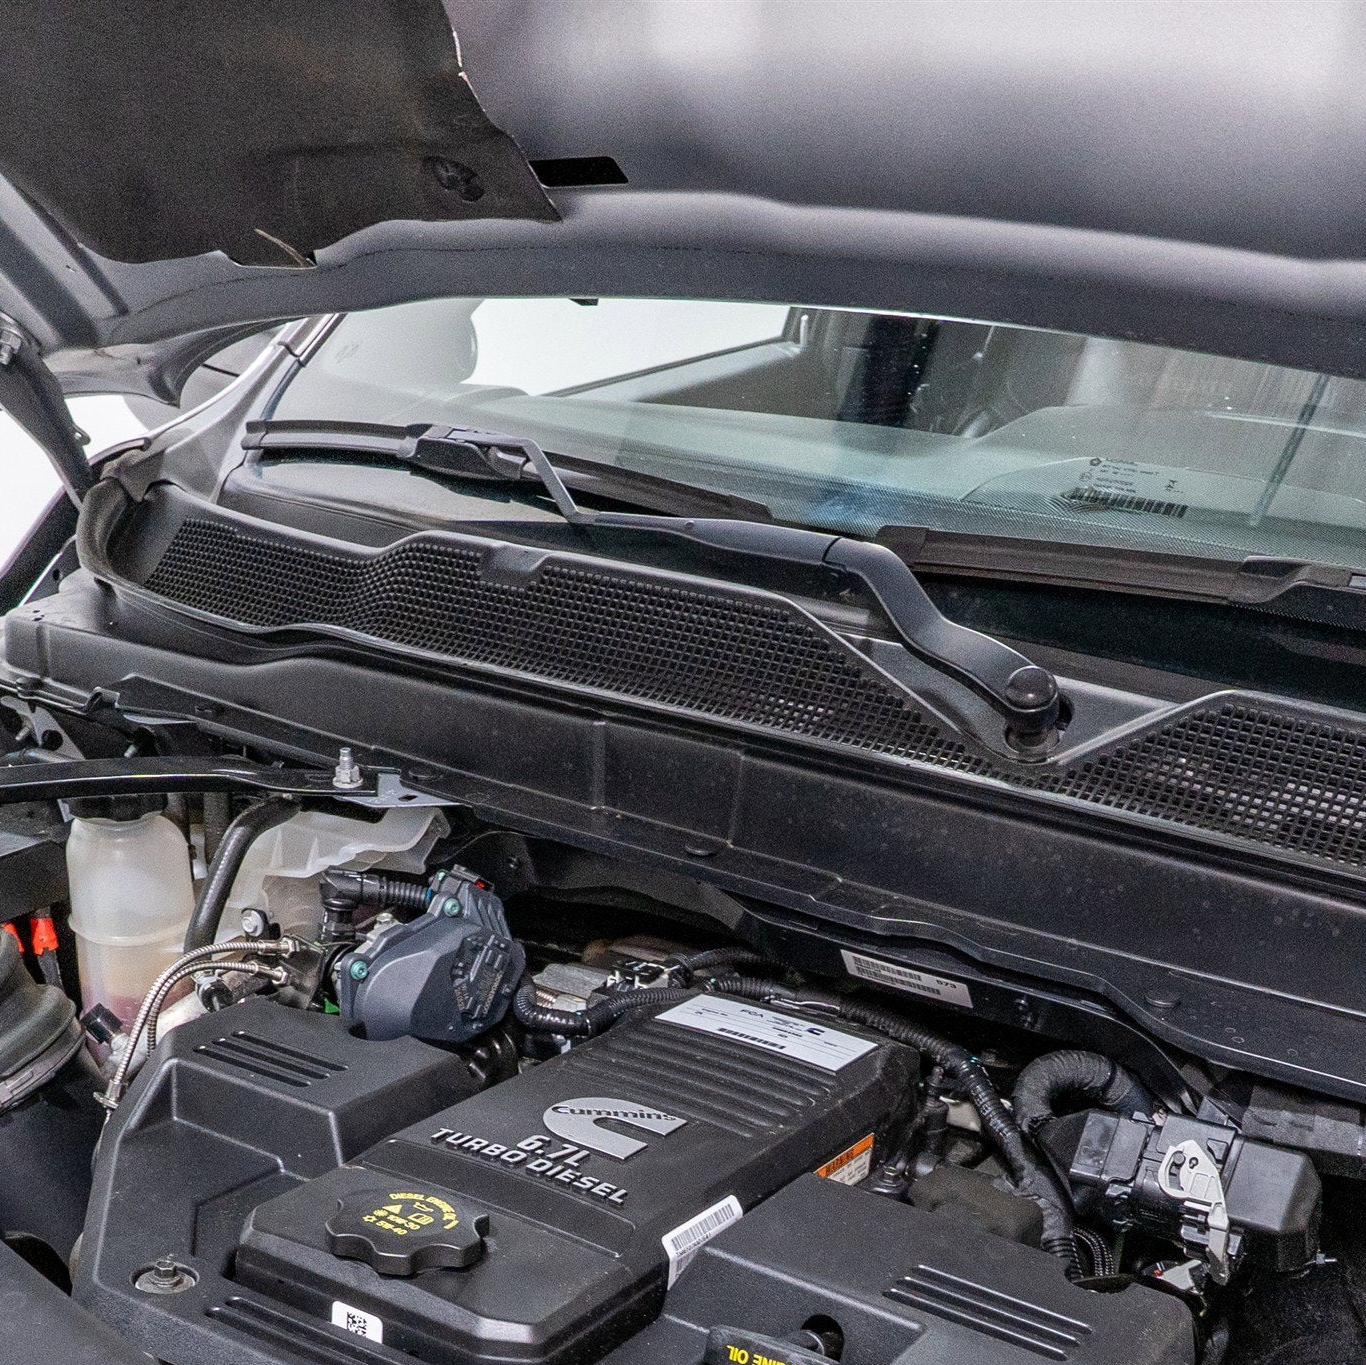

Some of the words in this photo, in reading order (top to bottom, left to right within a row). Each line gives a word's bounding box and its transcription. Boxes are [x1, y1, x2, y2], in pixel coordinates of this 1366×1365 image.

[551, 1105, 677, 1122] Cummins
[517, 1135, 590, 1167] 6.7L
[431, 1127, 528, 1164] TURBO
[526, 1157, 629, 1204] DIESEL
[388, 1192, 425, 1200] DIESEL
[726, 1344, 749, 1365] OIL
